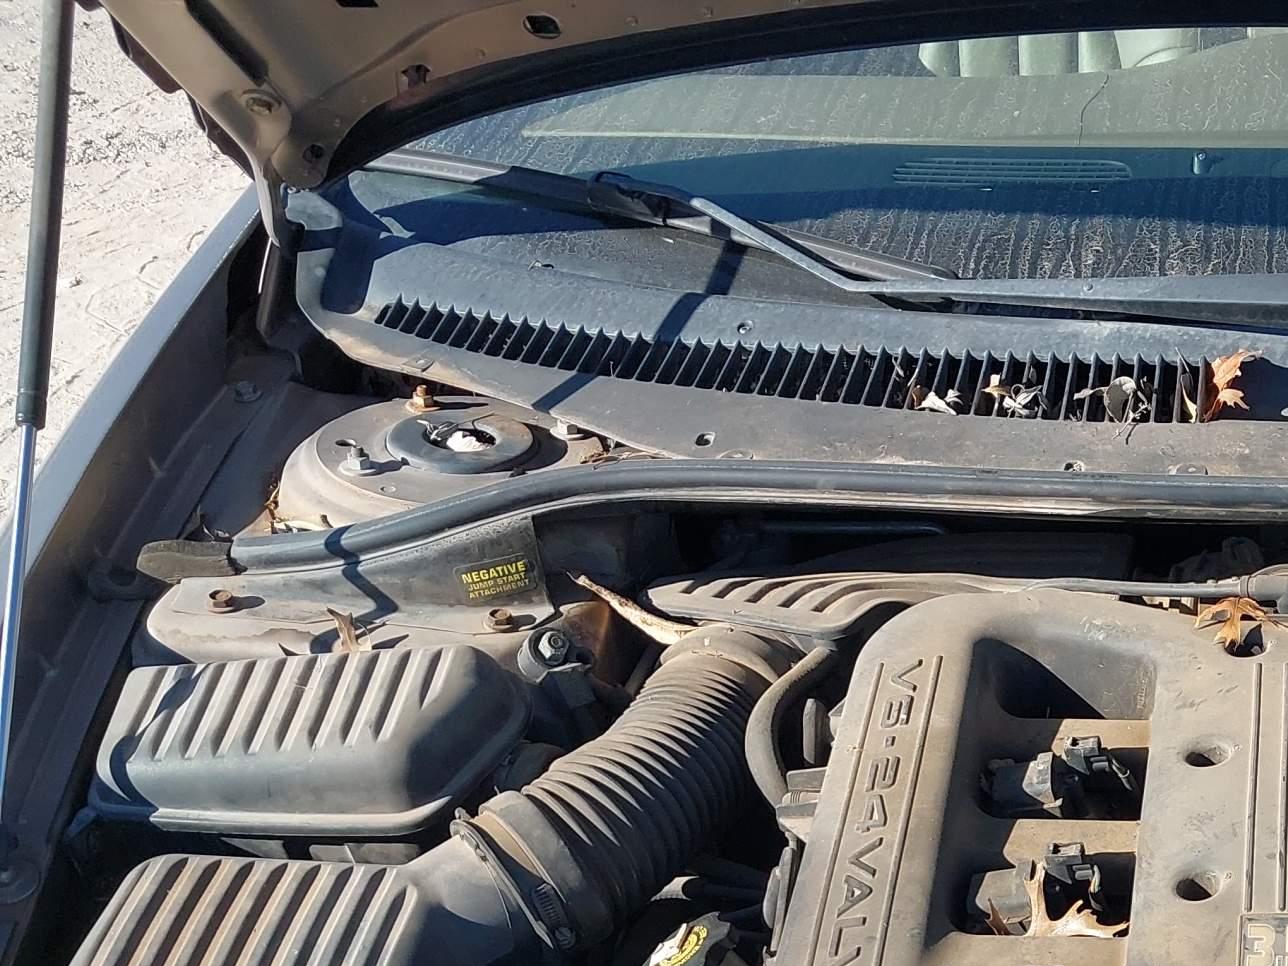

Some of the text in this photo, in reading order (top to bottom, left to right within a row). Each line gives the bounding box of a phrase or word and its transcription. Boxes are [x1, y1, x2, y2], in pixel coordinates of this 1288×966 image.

[461, 561, 526, 584] NEGATIVE
[468, 573, 525, 591] JUMP START
[469, 579, 529, 599] ATTACHMENT
